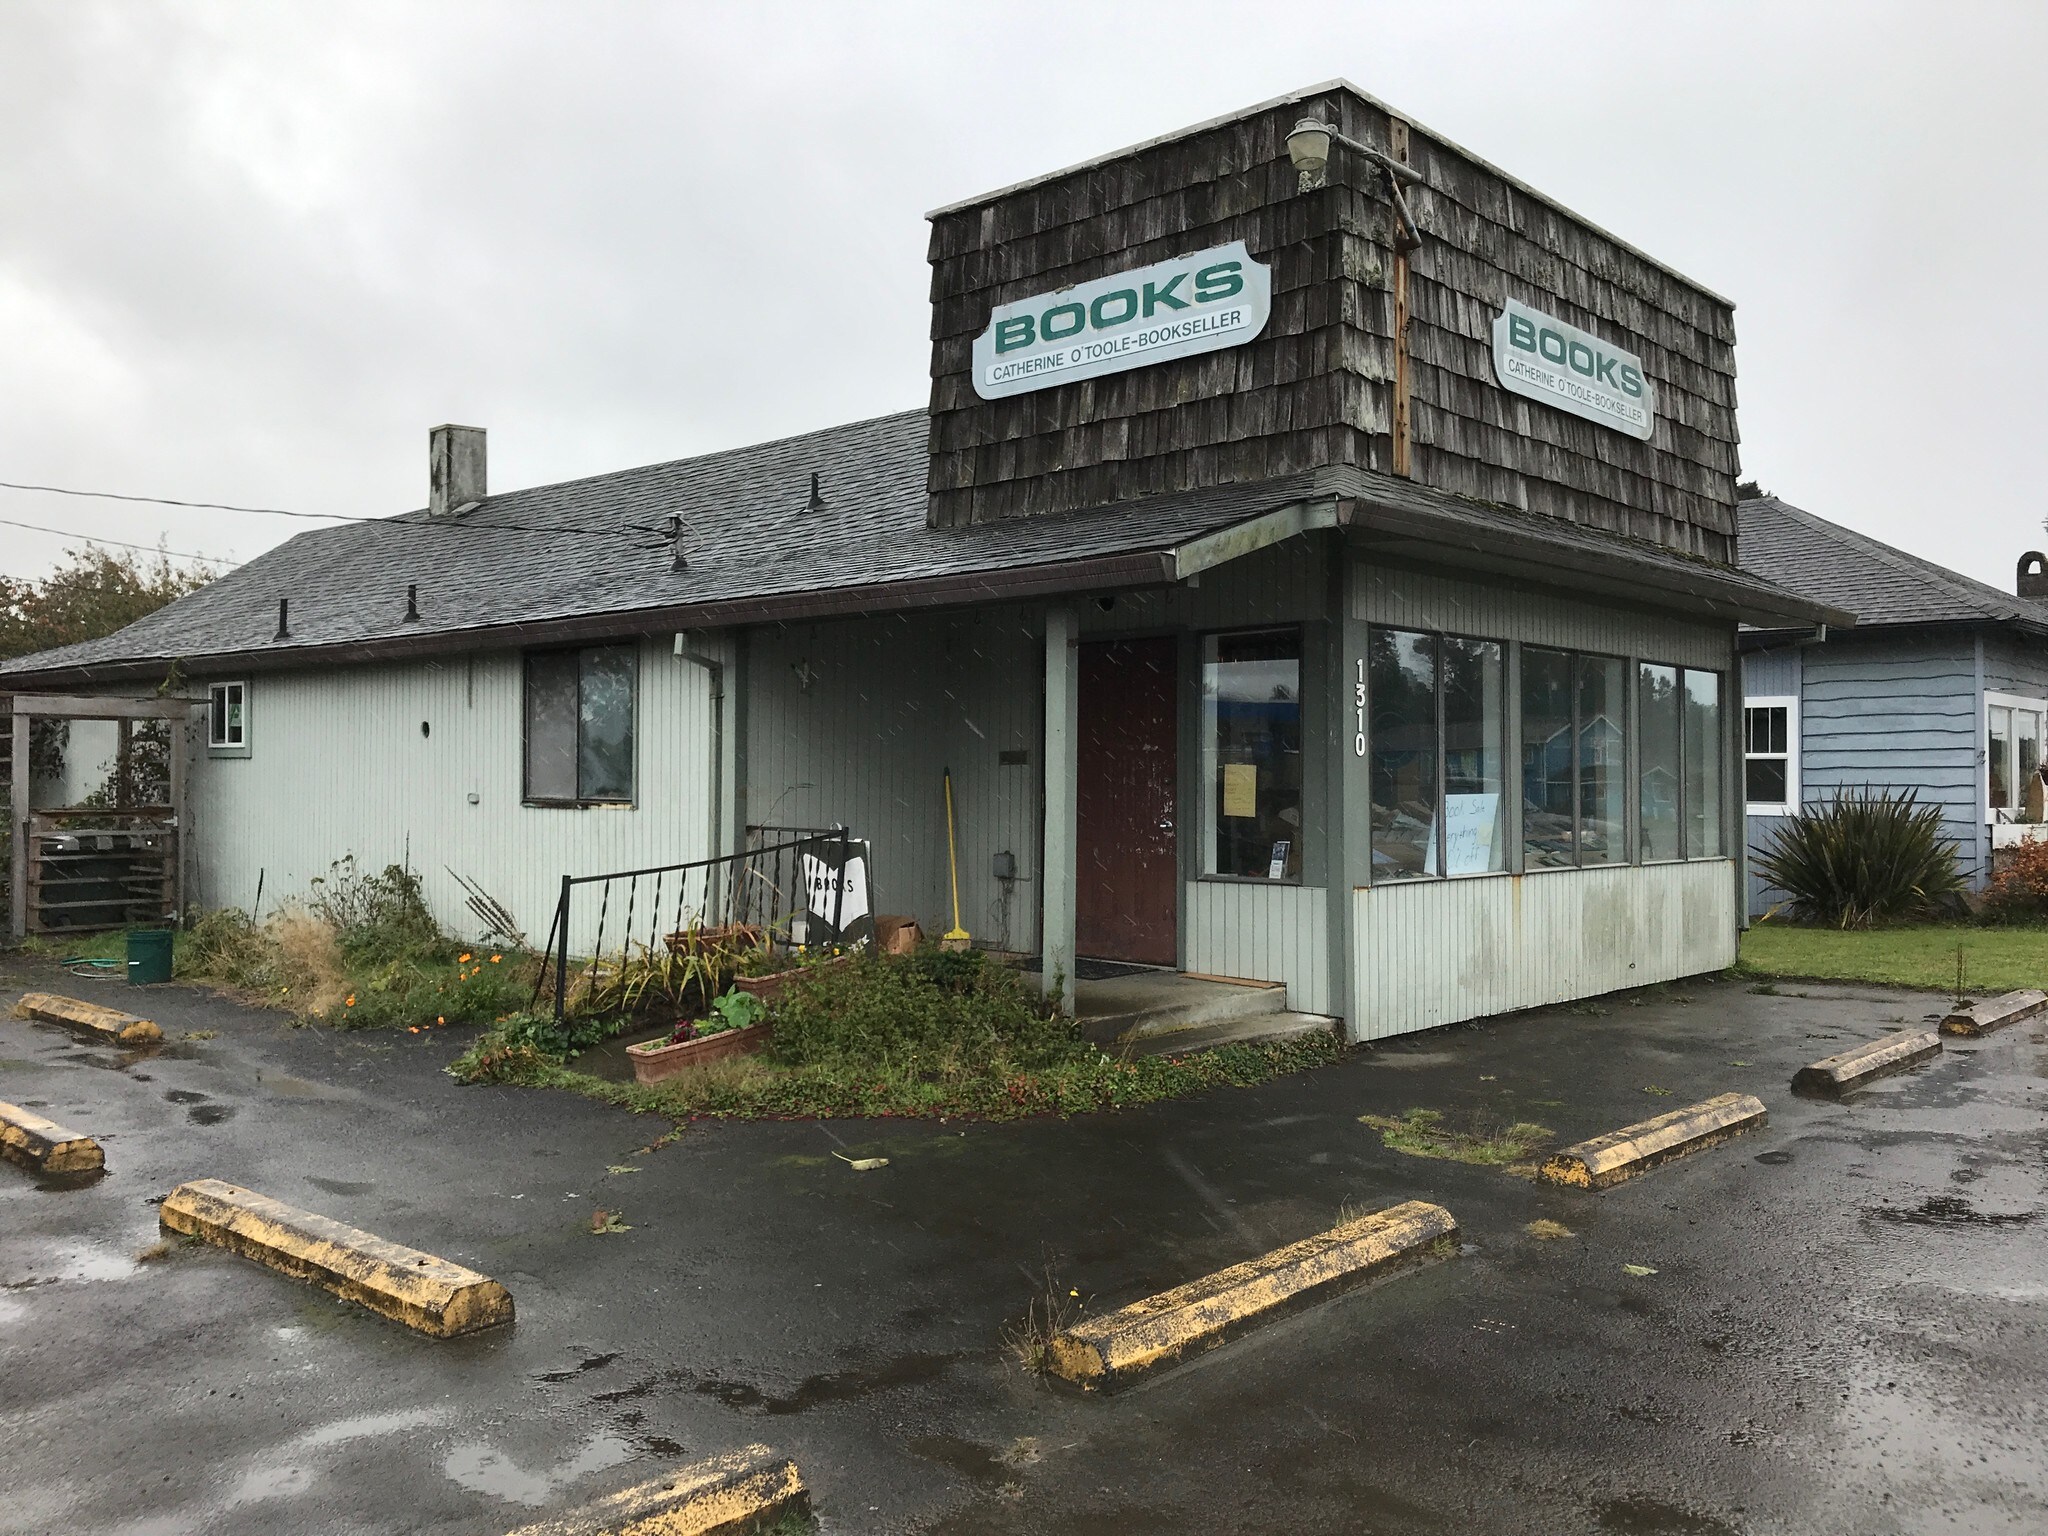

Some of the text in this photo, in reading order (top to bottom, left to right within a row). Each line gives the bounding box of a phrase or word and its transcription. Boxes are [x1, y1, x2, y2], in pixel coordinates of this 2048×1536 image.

[993, 310, 1241, 380] CATHERINE O'TOOLE-BOOKSELLER
[995, 261, 1243, 353] BOOKS
[1508, 359, 1642, 423] CATHERINE O'TOOLE-BOOKSELLER
[1510, 313, 1642, 398] BOOKS
[1356, 659, 1366, 756] 1310
[815, 877, 853, 892] BOS
